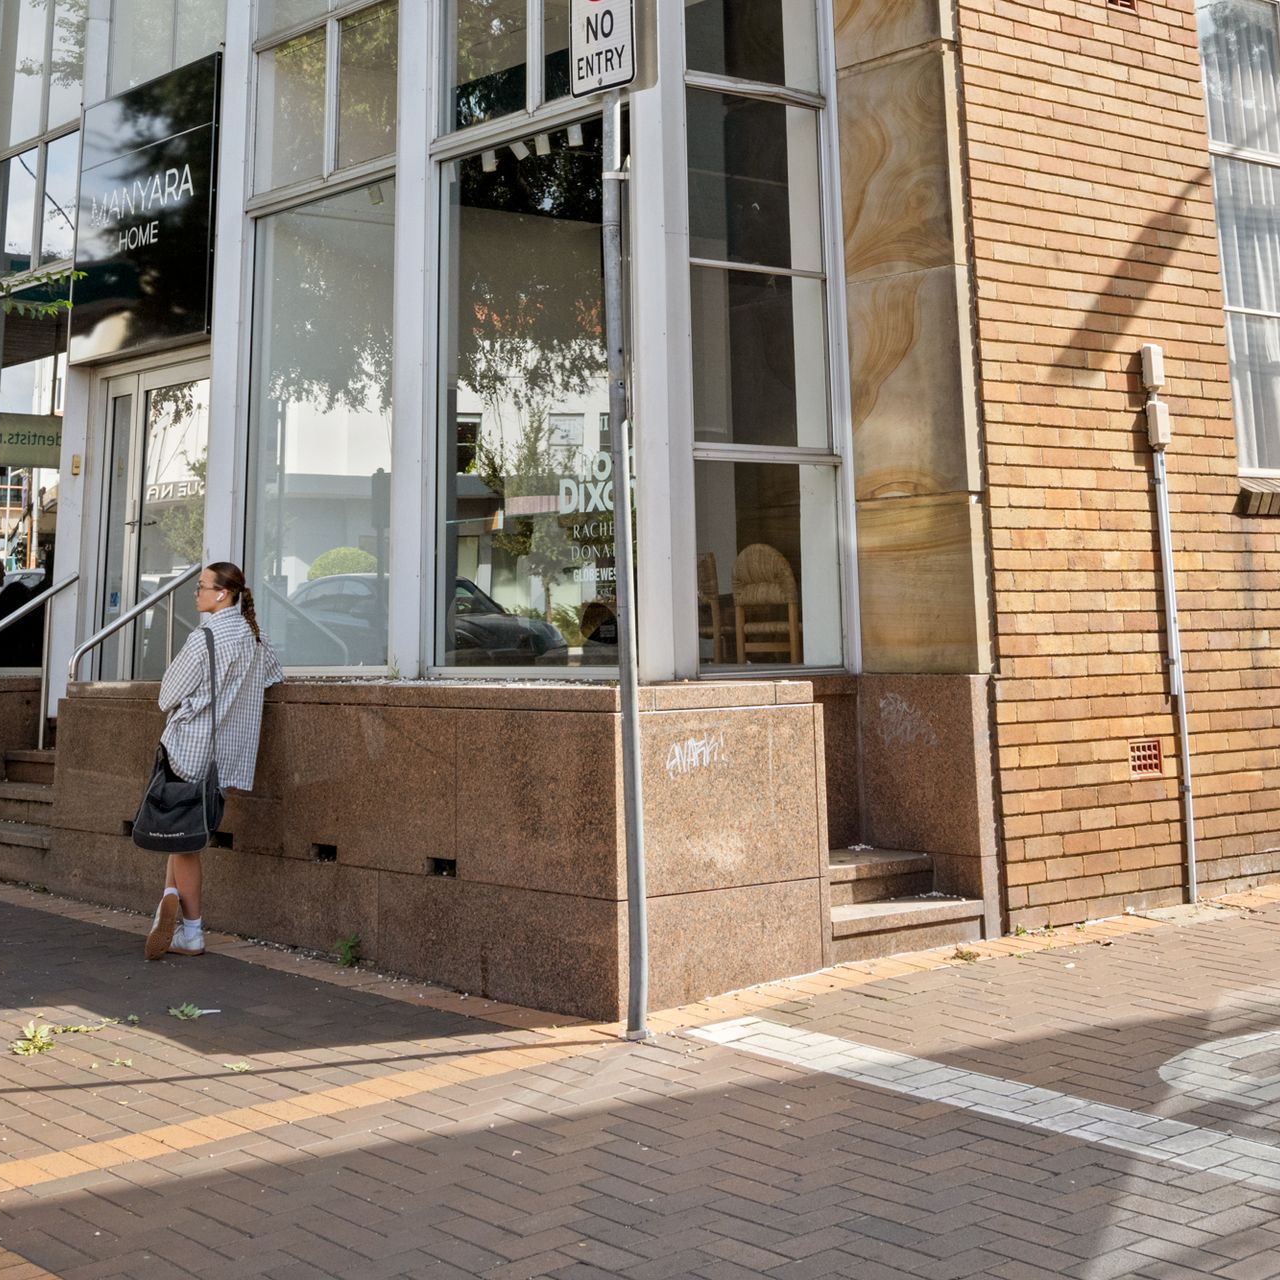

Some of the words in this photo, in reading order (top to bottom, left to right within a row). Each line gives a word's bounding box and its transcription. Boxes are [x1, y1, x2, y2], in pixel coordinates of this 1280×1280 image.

[585, 8, 614, 45] NO
[577, 43, 626, 81] ENTRY
[90, 163, 194, 228] MANYARA
[118, 220, 159, 252] HOME
[559, 478, 625, 515] DIXO
[573, 521, 616, 539] RACHE
[573, 567, 617, 582] GLOBEWES
